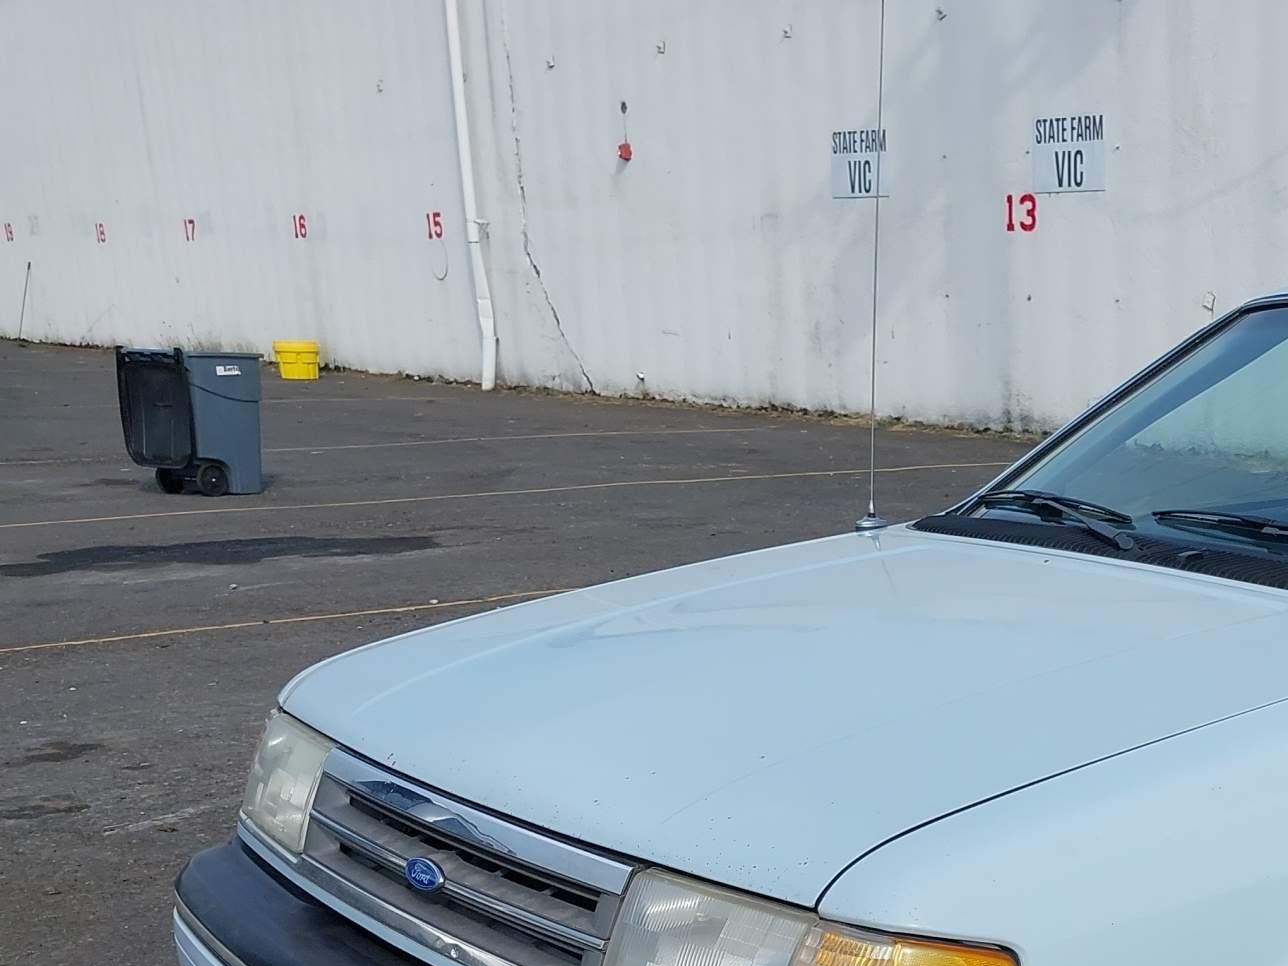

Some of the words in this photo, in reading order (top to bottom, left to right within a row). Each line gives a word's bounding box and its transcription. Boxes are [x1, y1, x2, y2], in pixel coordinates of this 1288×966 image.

[832, 131, 858, 154] STATE
[860, 129, 886, 153] FARM
[1035, 117, 1067, 145] STATE
[1070, 115, 1103, 142] FARM
[848, 160, 872, 193] VIC
[1054, 150, 1084, 188] VIC
[427, 212, 443, 239] 15
[1006, 193, 1037, 232] 13
[95, 223, 106, 243] 18
[184, 219, 195, 241] 17
[293, 214, 307, 239] 16
